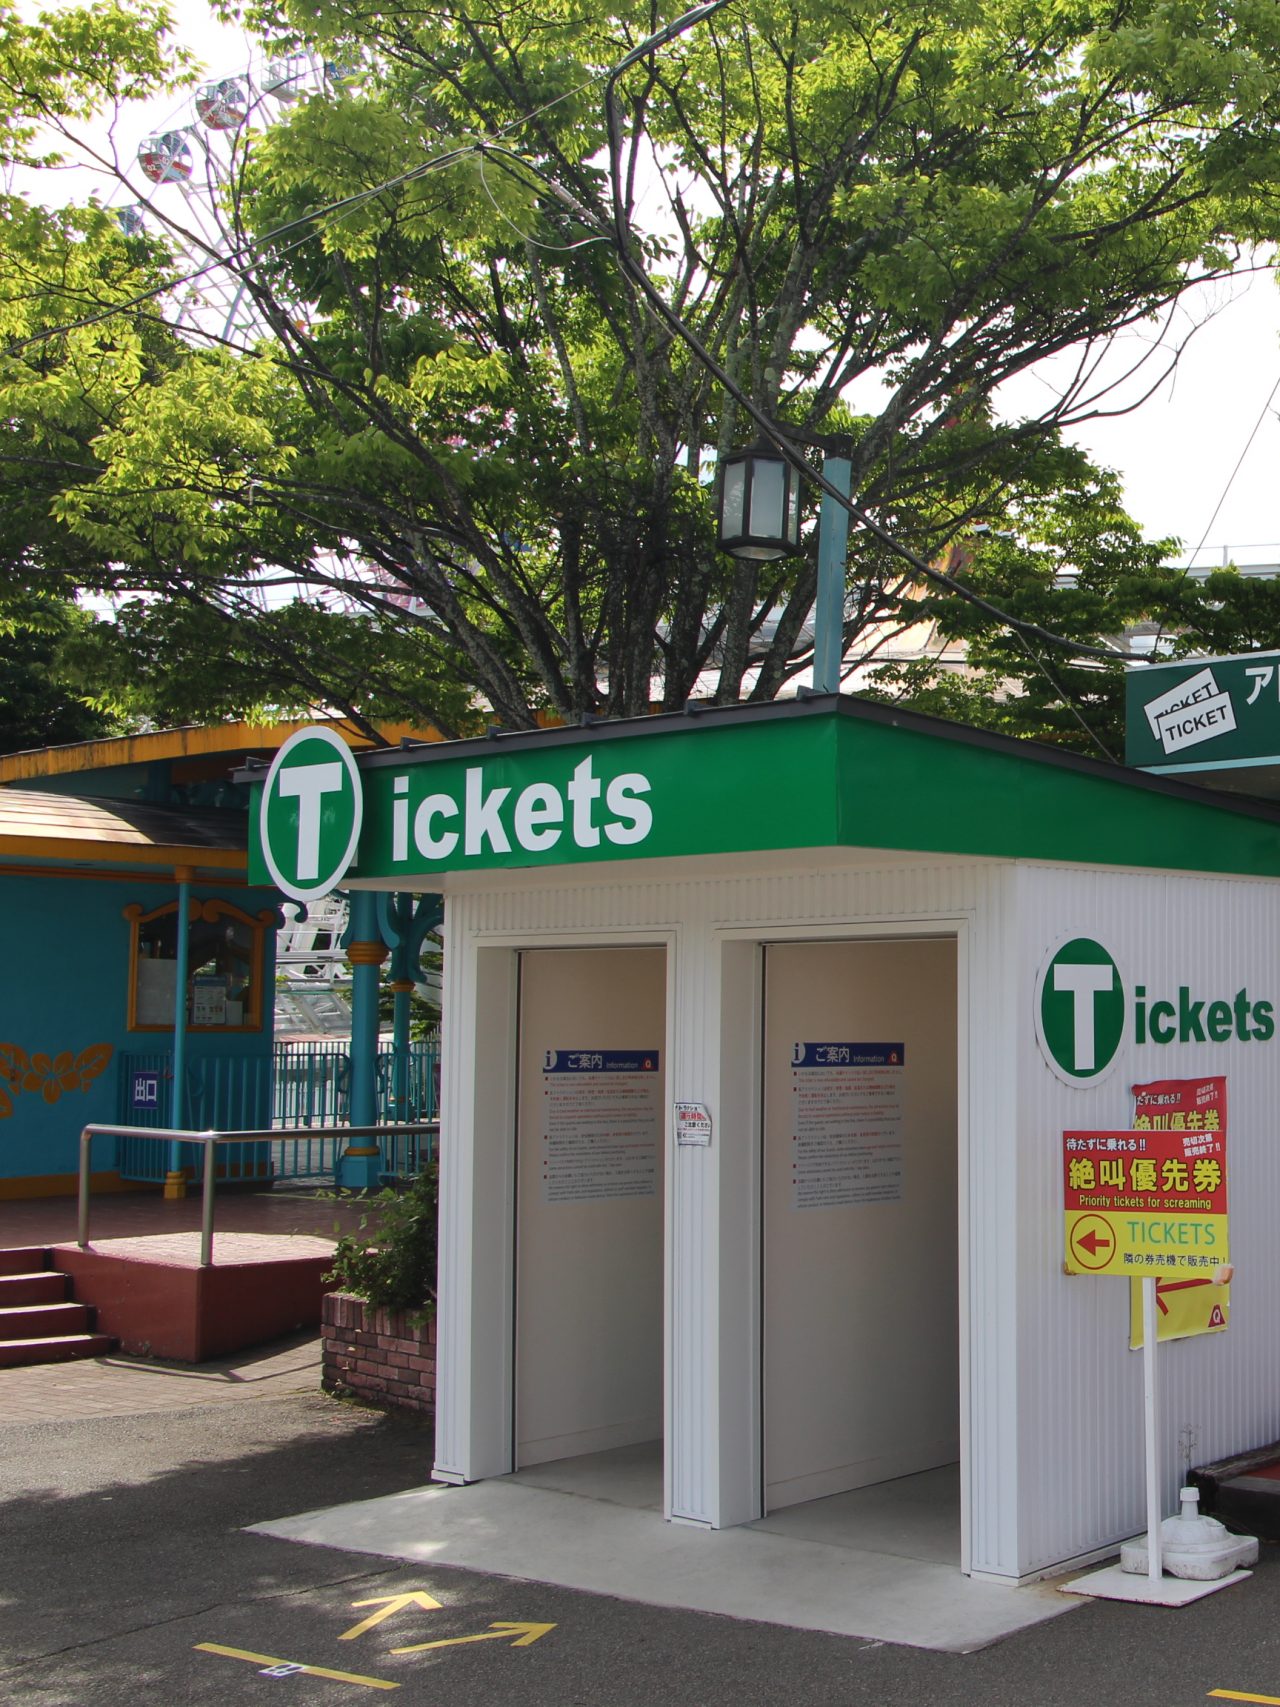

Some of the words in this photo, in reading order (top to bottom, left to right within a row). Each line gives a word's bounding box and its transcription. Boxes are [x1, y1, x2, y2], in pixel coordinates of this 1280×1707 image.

[1165, 704, 1227, 741] TICKET
[568, 1053, 603, 1069] ご案内
[816, 1046, 850, 1063] ご案内
[134, 1078, 157, 1102] 出口
[1066, 1138, 1146, 1151] 待たずに乗れる!!
[1068, 1157, 1222, 1192] 絶叫優先券
[1079, 1194, 1111, 1208] Priority
[1114, 1195, 1144, 1207] tickets
[1148, 1196, 1160, 1208] for
[1164, 1198, 1212, 1210] screaming
[1126, 1221, 1216, 1245] TICKETS
